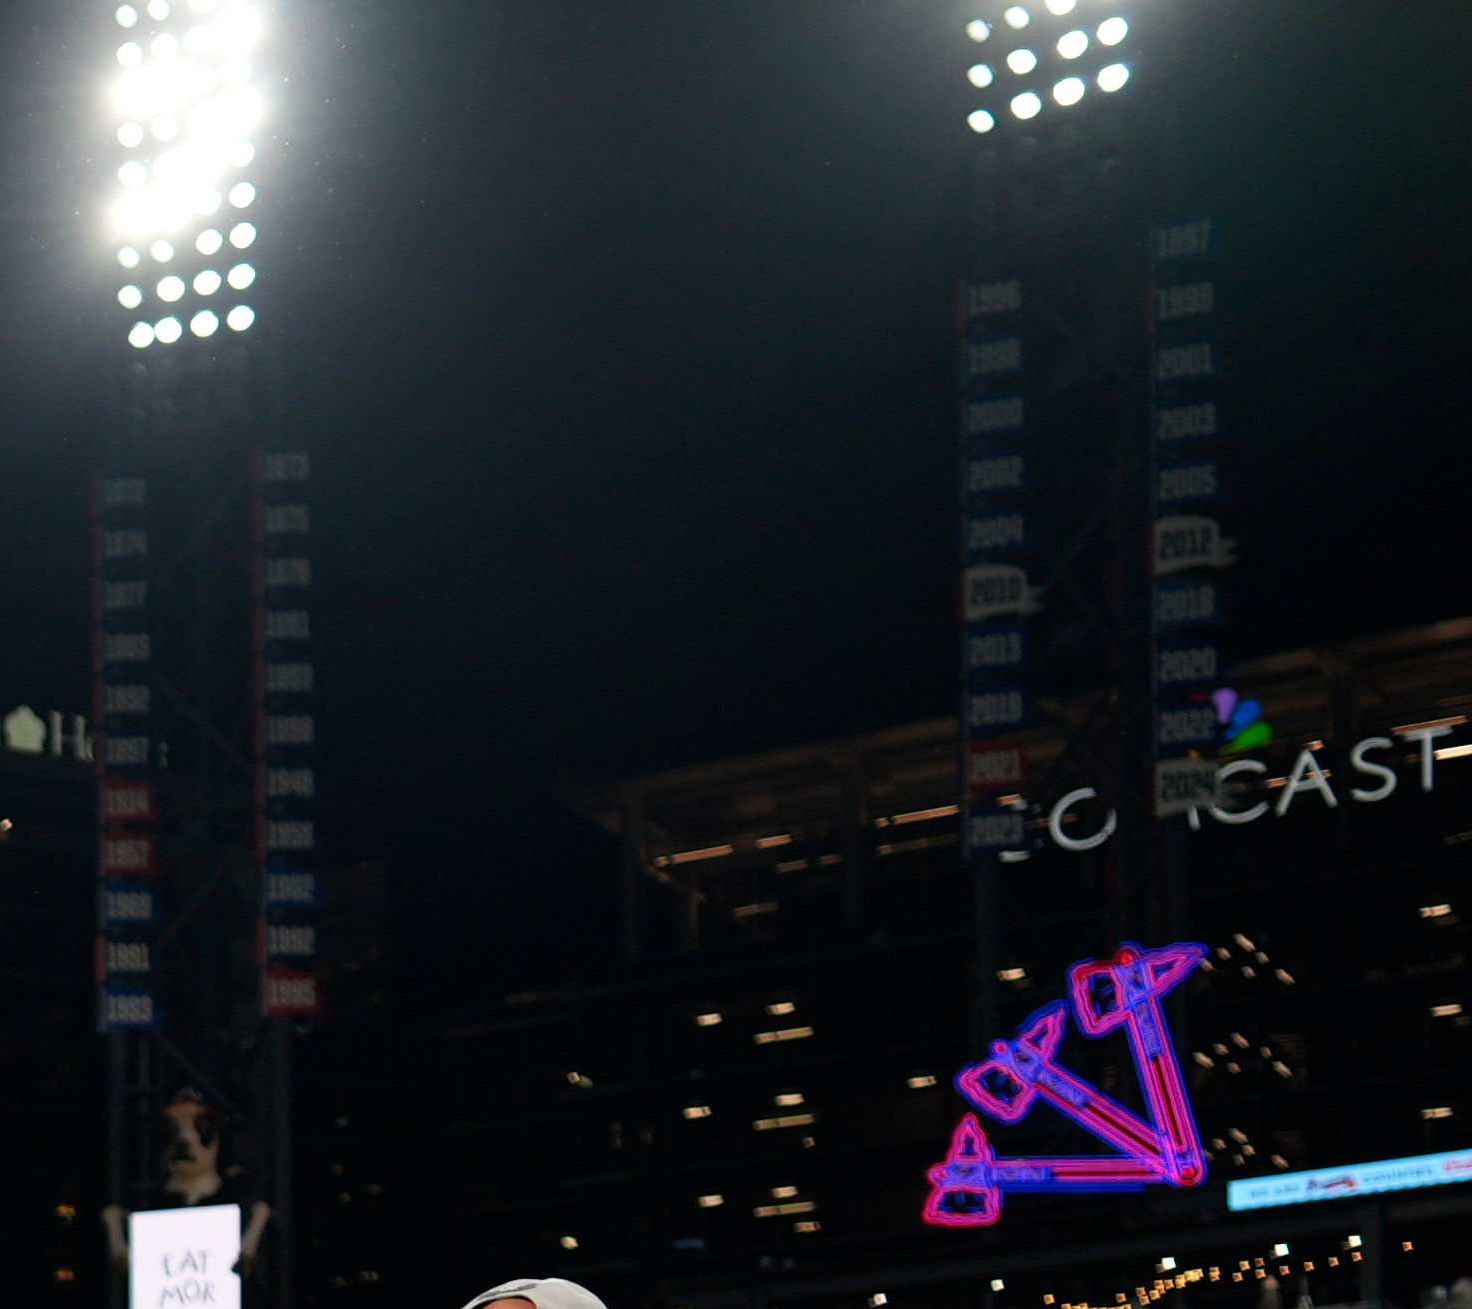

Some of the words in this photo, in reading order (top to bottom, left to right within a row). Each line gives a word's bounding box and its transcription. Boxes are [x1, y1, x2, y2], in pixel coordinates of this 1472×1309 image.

[999, 724, 1454, 862] OCAST
[159, 1249, 214, 1276] EAT
[158, 1278, 217, 1308] MOR
